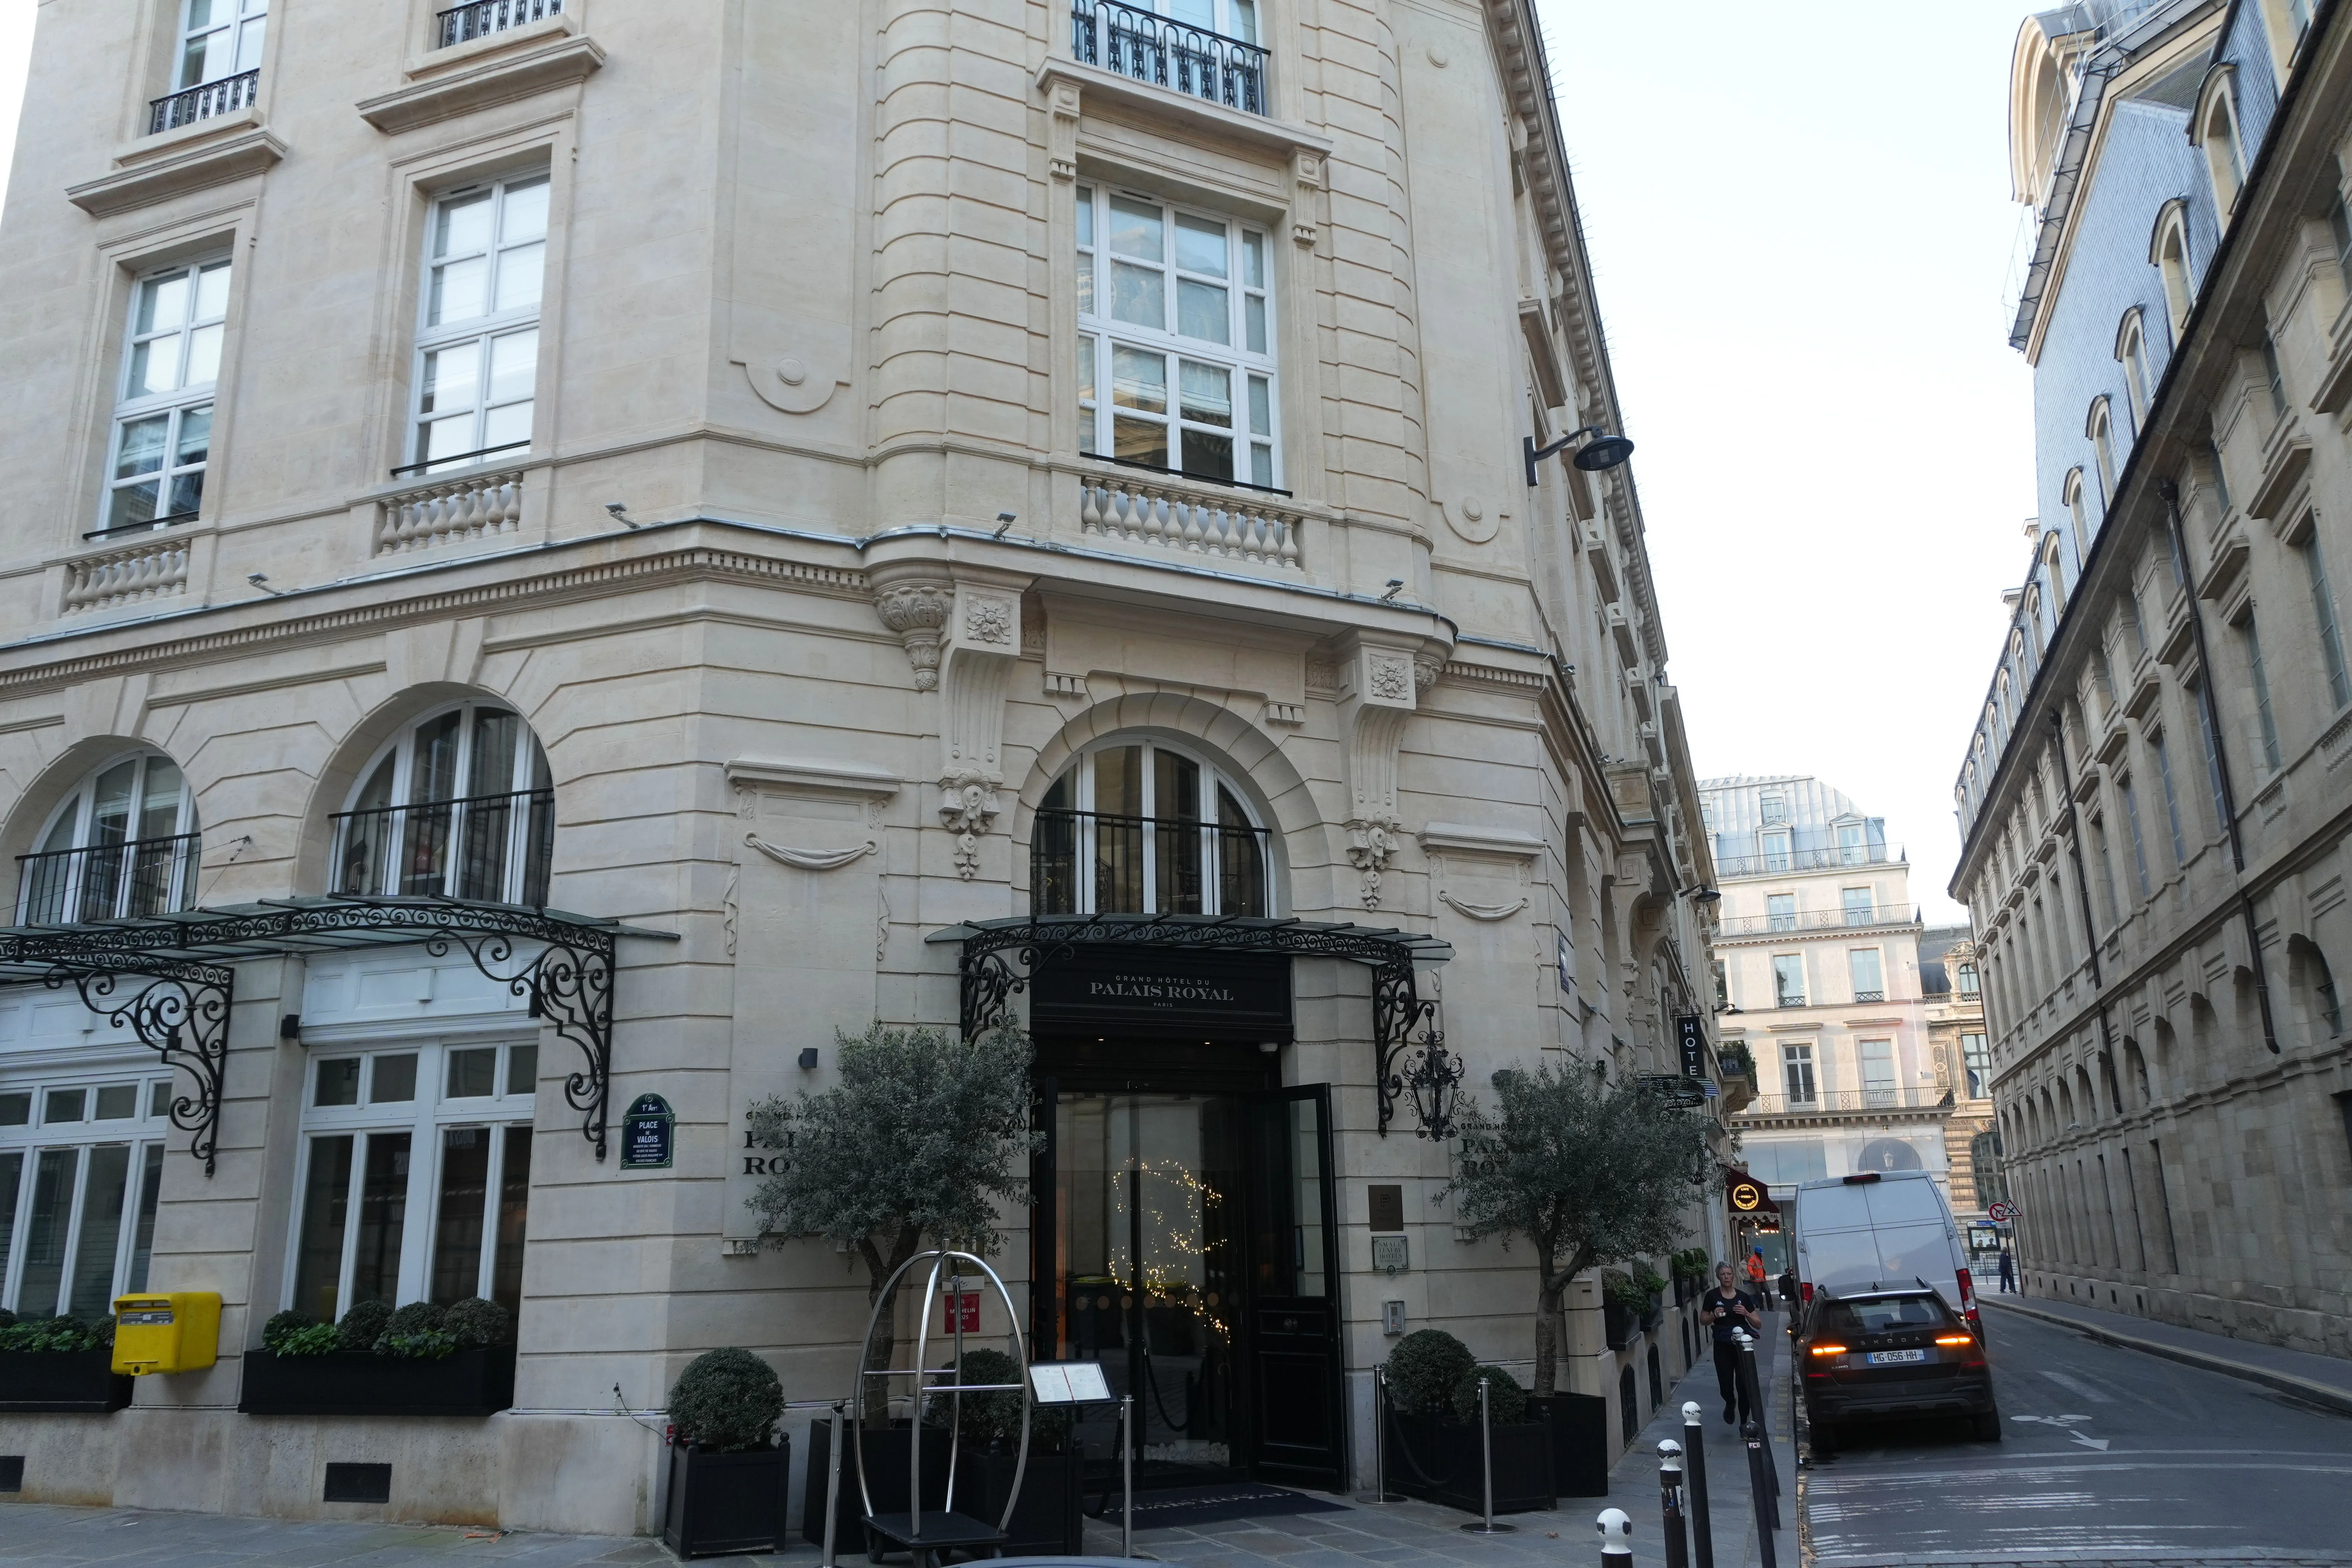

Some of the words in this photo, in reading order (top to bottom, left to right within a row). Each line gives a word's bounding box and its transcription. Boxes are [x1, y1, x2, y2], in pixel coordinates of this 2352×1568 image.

[1090, 982, 1162, 997] PALAIS
[1167, 986, 1234, 1001] ROYAL
[1684, 1023, 1698, 1075] HOTE
[1860, 1336, 1920, 1345] SKODA
[1873, 1351, 1917, 1362] HG-056-HH
